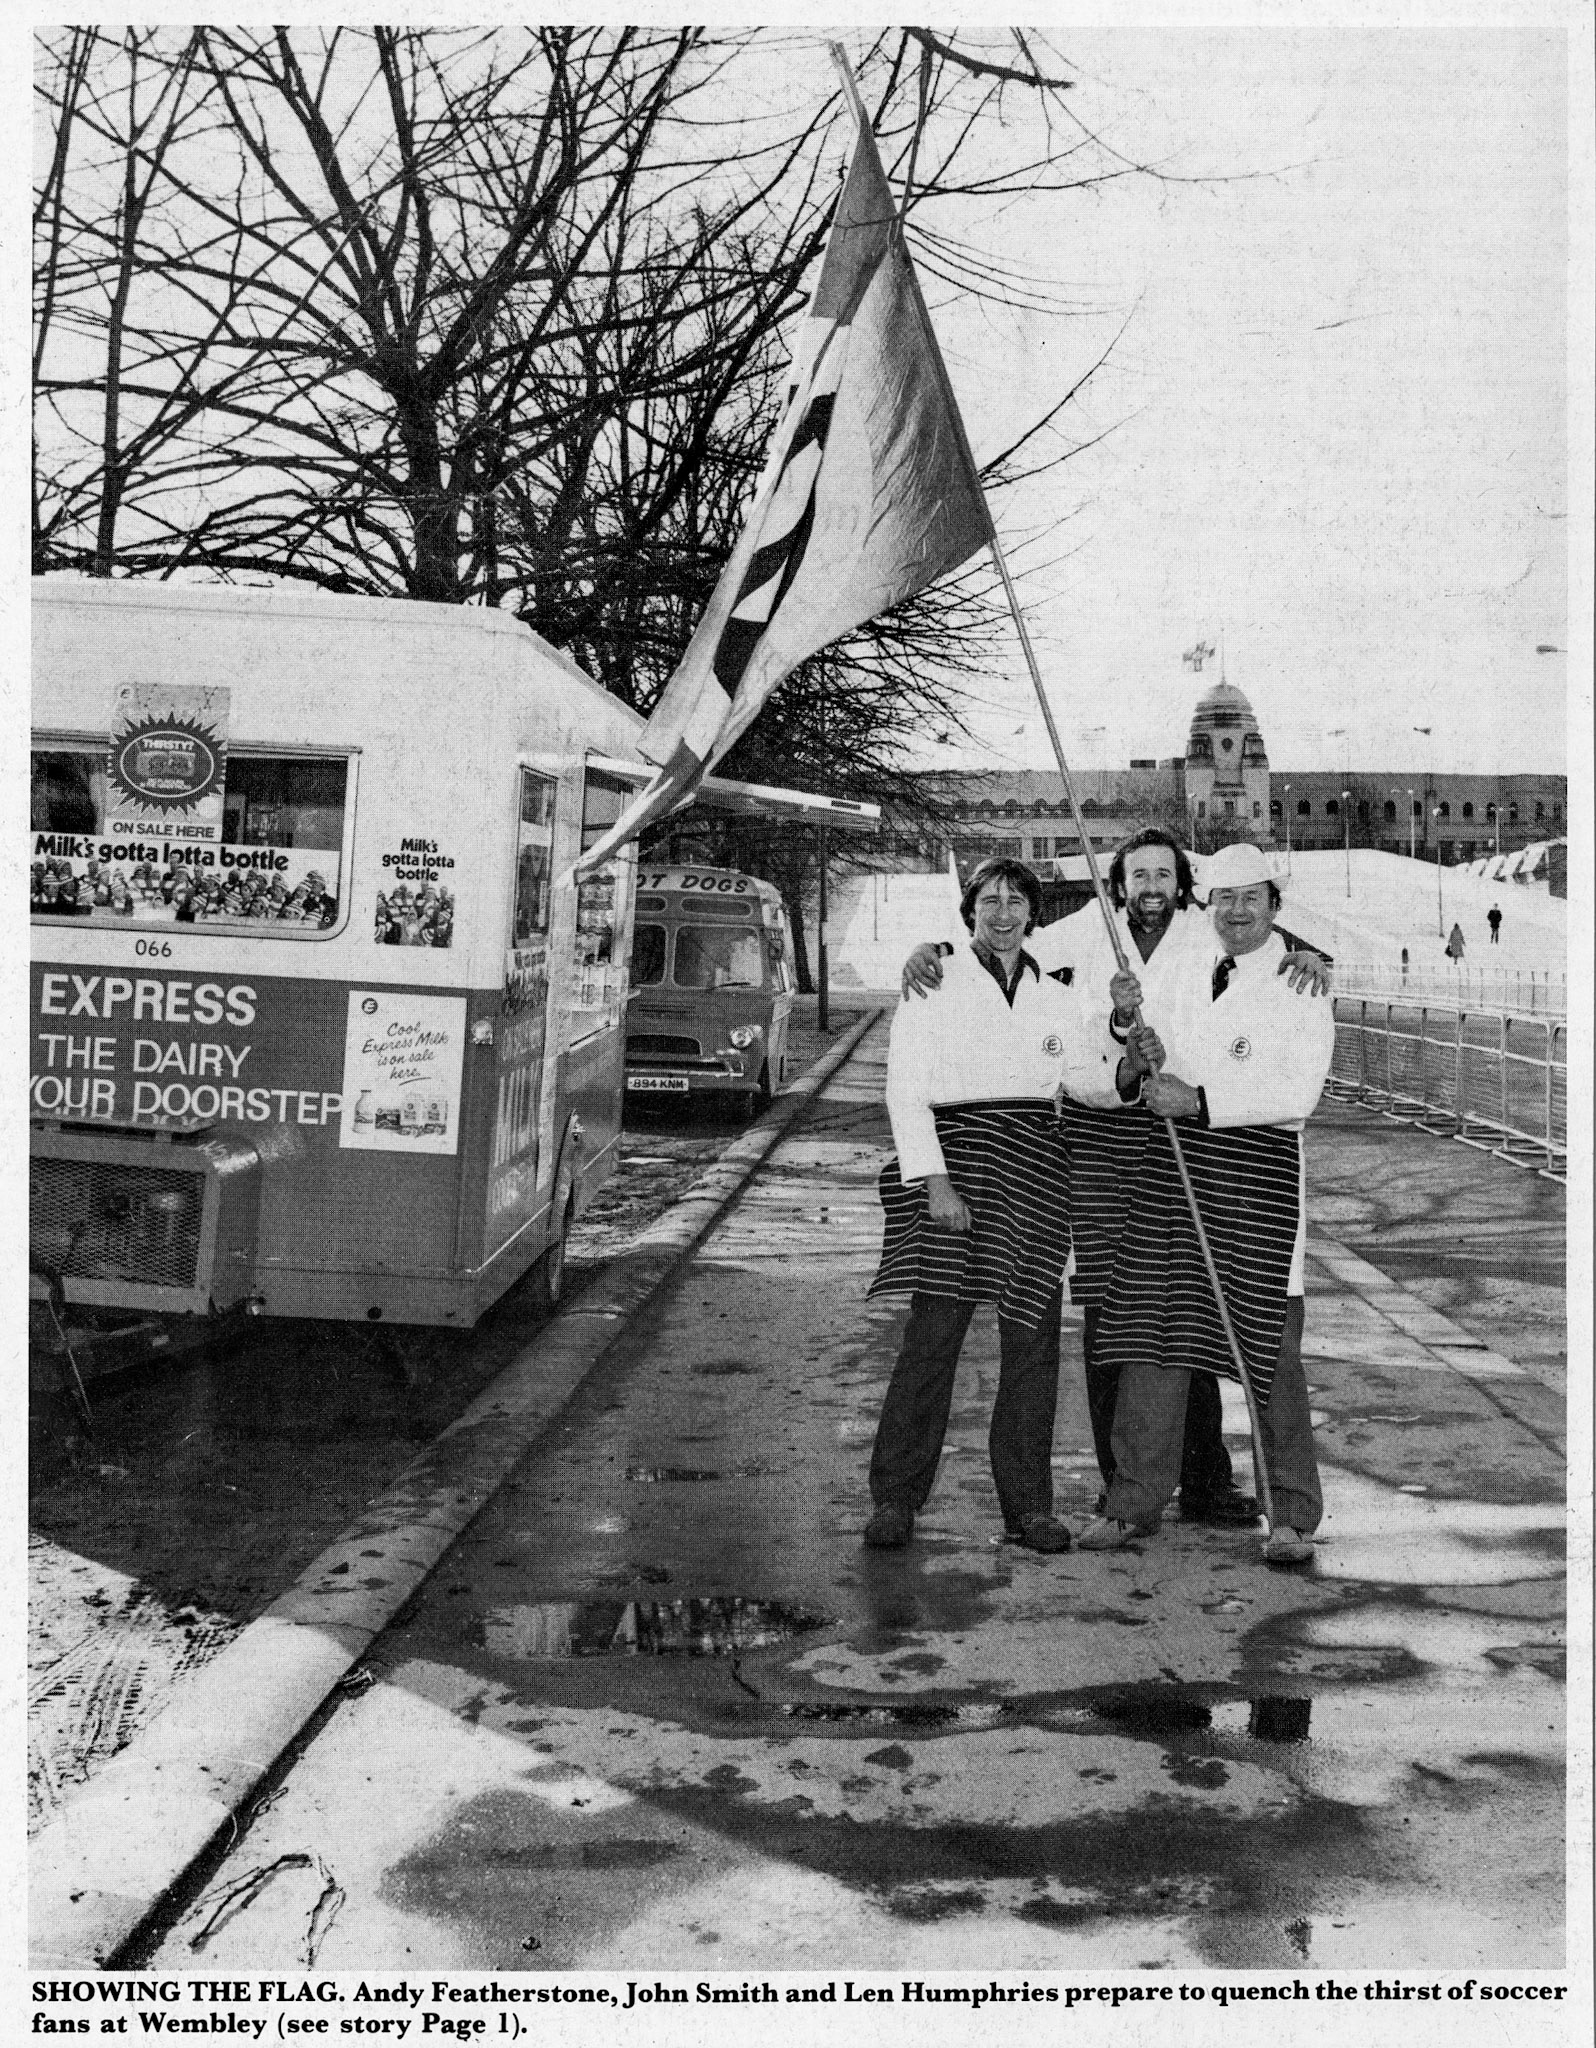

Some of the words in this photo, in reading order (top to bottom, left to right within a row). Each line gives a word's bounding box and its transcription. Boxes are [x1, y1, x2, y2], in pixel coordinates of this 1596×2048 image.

[112, 822, 134, 835] ON
[136, 823, 173, 836] SALE
[176, 825, 215, 839] HERE
[34, 834, 95, 858] Milk's
[98, 842, 158, 864] gotta
[163, 842, 215, 866] lotta
[219, 846, 289, 871] bottle
[400, 838, 438, 853] Milk's
[382, 854, 420, 867] gotta
[422, 853, 455, 868] lotta
[395, 866, 439, 881] bottle
[636, 873, 667, 889] OT
[680, 874, 749, 893] DOGS
[135, 939, 173, 958] 066
[40, 972, 258, 1027] EXPRESS
[387, 1021, 421, 1036] Cool
[362, 1038, 413, 1057] Express
[414, 1031, 449, 1047] Milk
[38, 1033, 116, 1072] THE
[133, 1039, 251, 1078] DAIRY
[409, 1049, 434, 1063] sale
[133, 1081, 343, 1126] DOORSTEP
